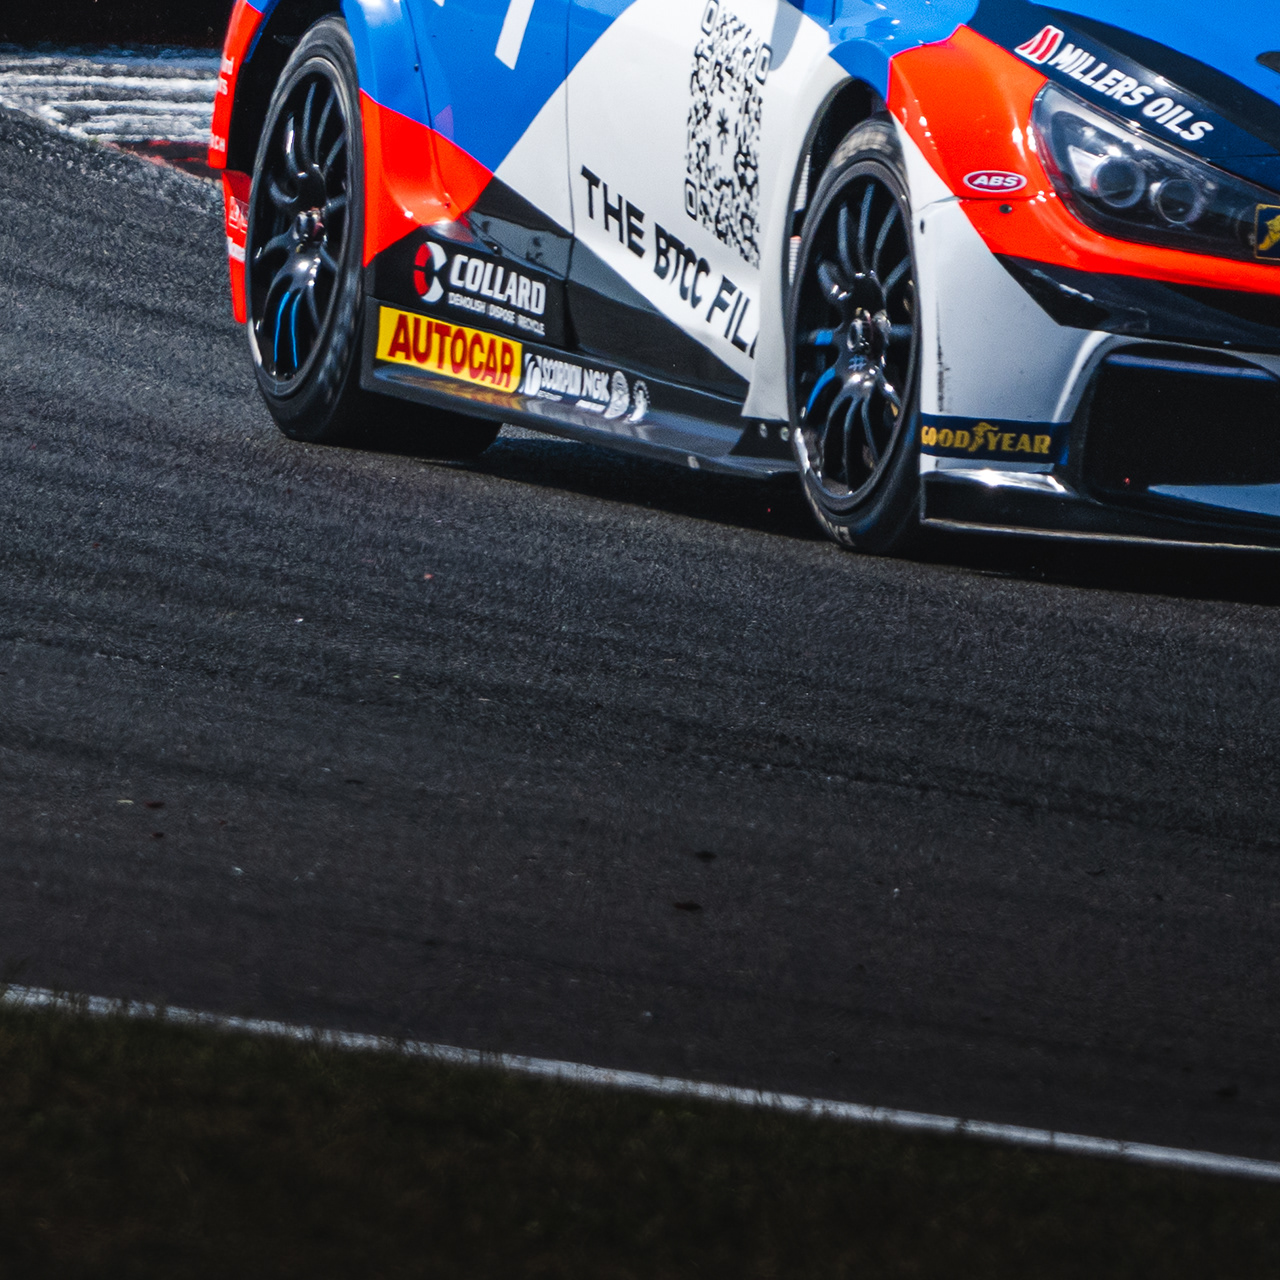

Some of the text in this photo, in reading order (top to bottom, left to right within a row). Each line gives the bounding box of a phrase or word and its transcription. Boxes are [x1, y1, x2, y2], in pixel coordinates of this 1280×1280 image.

[1047, 43, 1214, 141] MILLERS OILS
[971, 173, 1019, 189] ABS
[580, 164, 646, 259] THE
[653, 222, 711, 309] BTCC
[449, 253, 547, 316] COLLARD
[388, 313, 515, 389] AUTOCAR
[581, 369, 611, 403] NGK
[921, 422, 1052, 454] GOODYEAR
